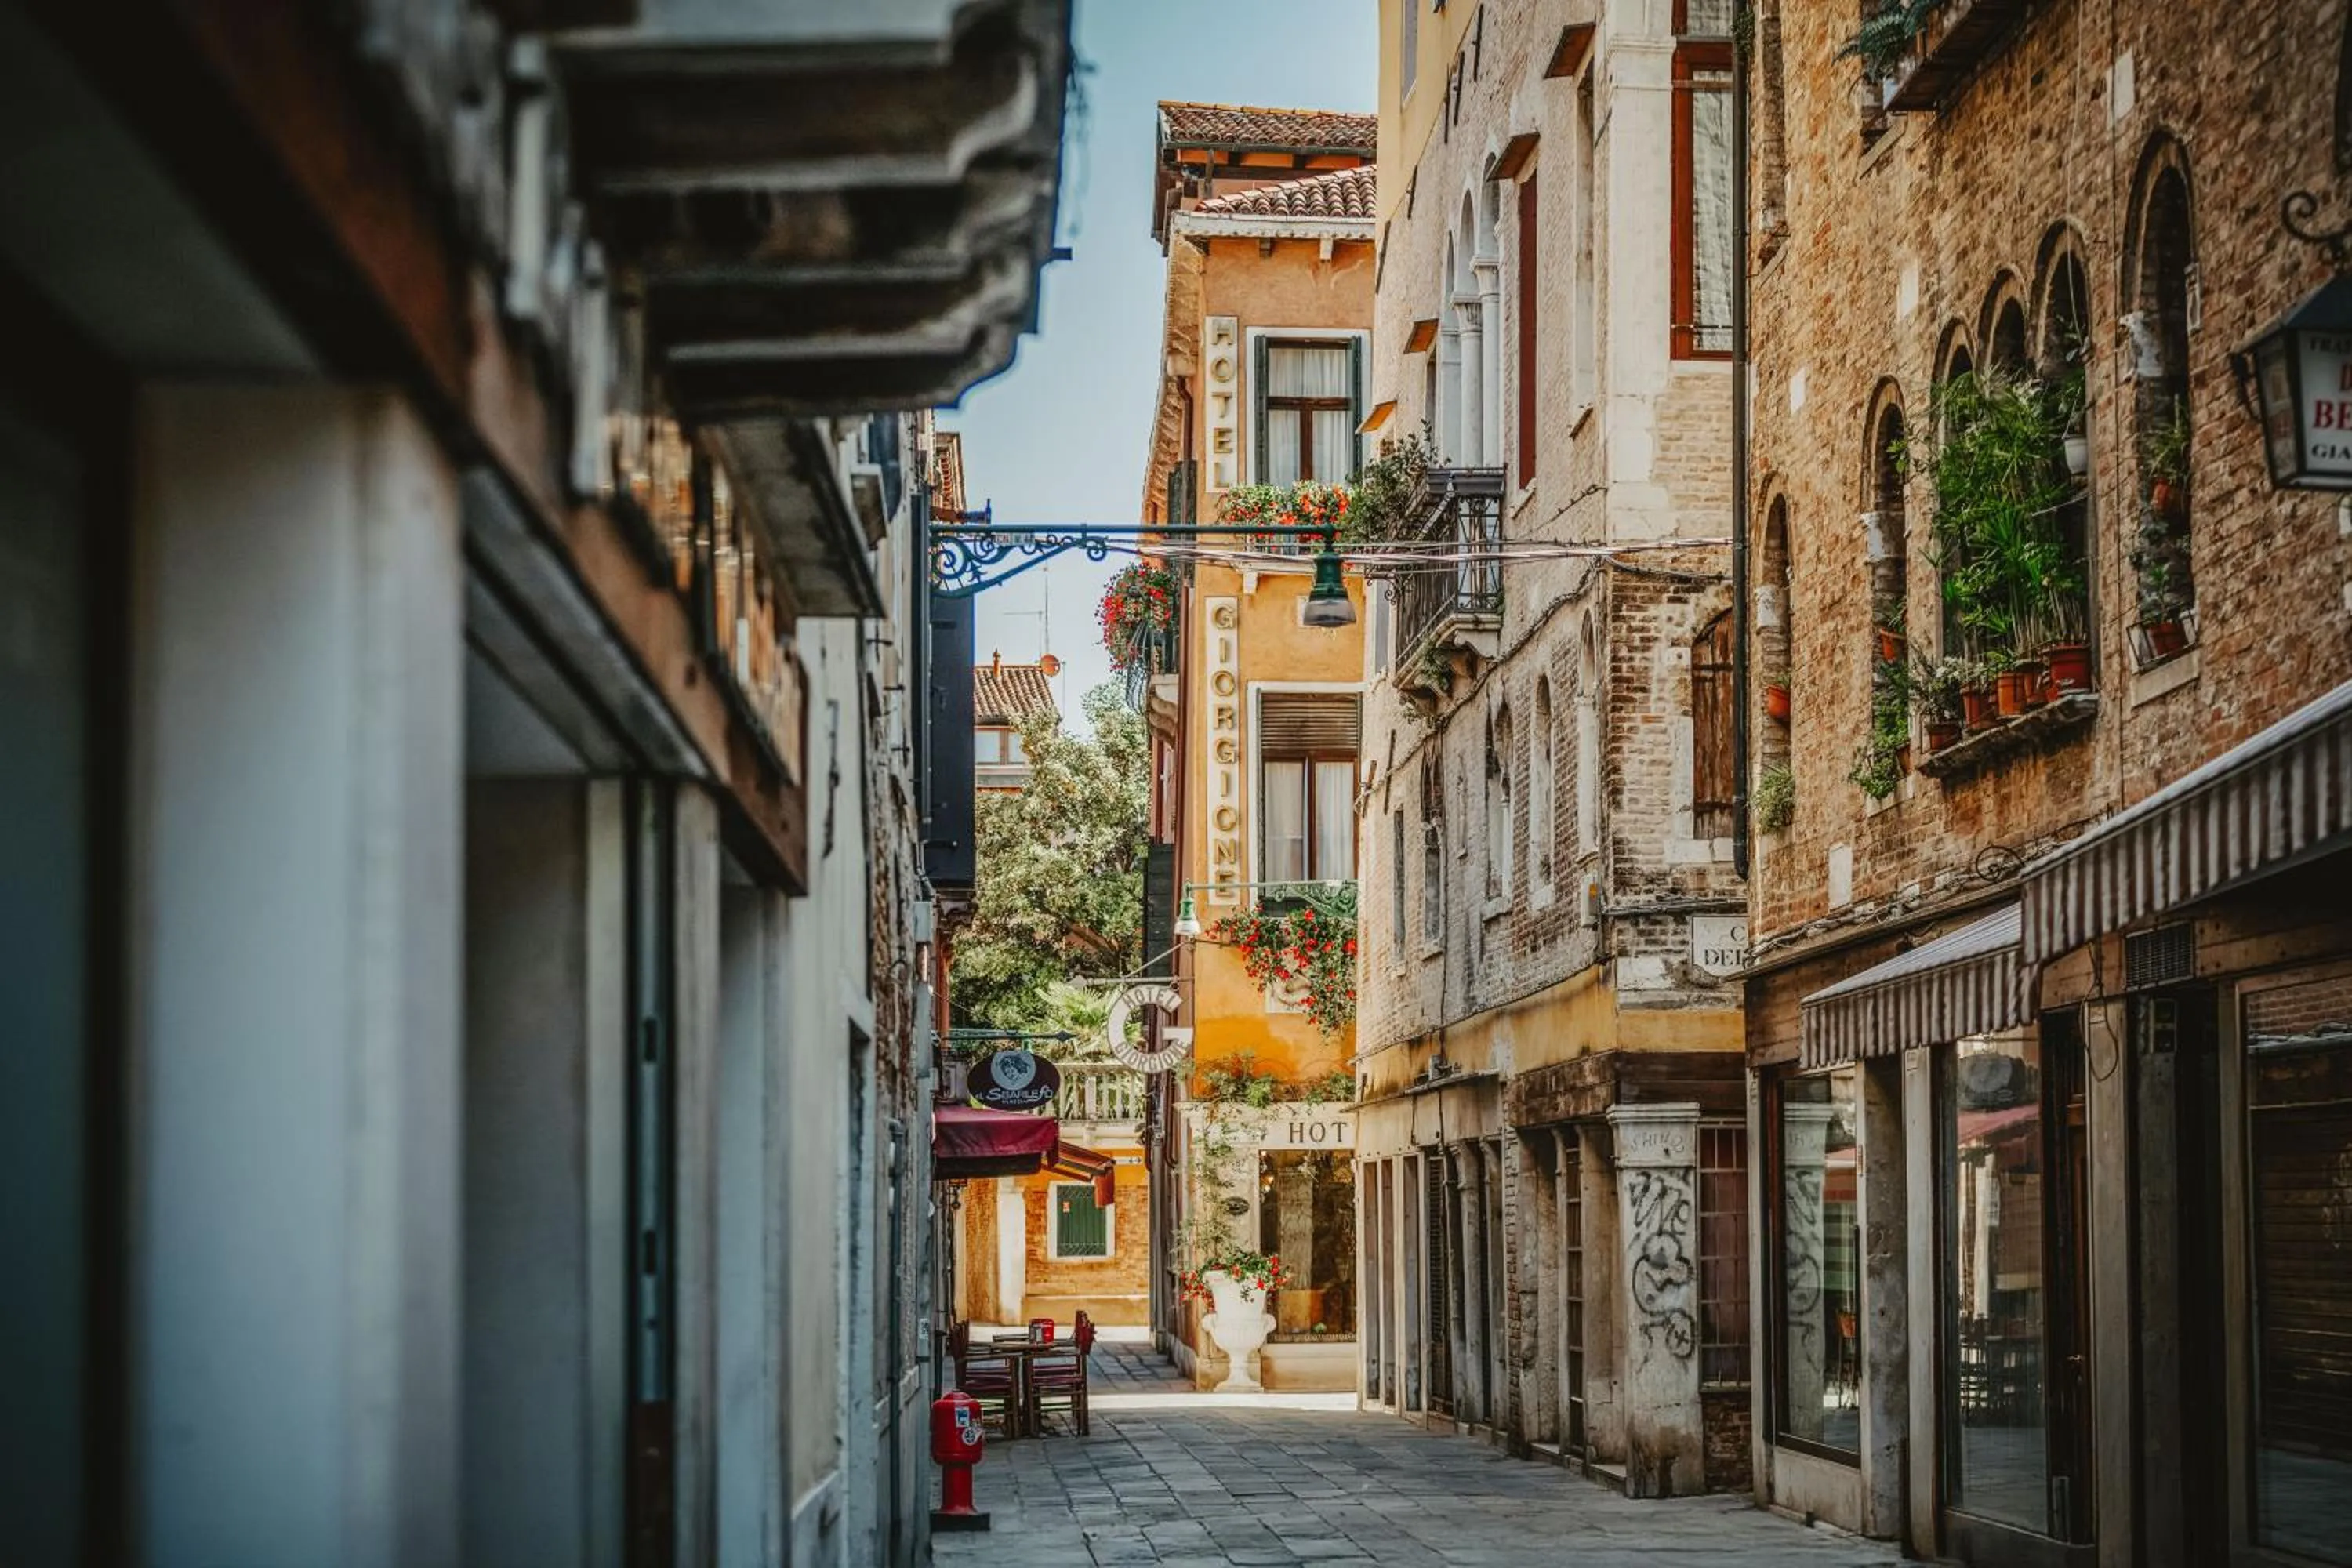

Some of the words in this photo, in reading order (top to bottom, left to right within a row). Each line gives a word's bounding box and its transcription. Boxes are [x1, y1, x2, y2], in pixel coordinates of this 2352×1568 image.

[1210, 319, 1235, 488] HOTEL
[1210, 604, 1238, 898] GIORGIONE
[1122, 986, 1176, 1011] HOTEL
[1114, 1038, 1189, 1072] GIORGIONE
[1288, 1121, 1348, 1143] HOT
